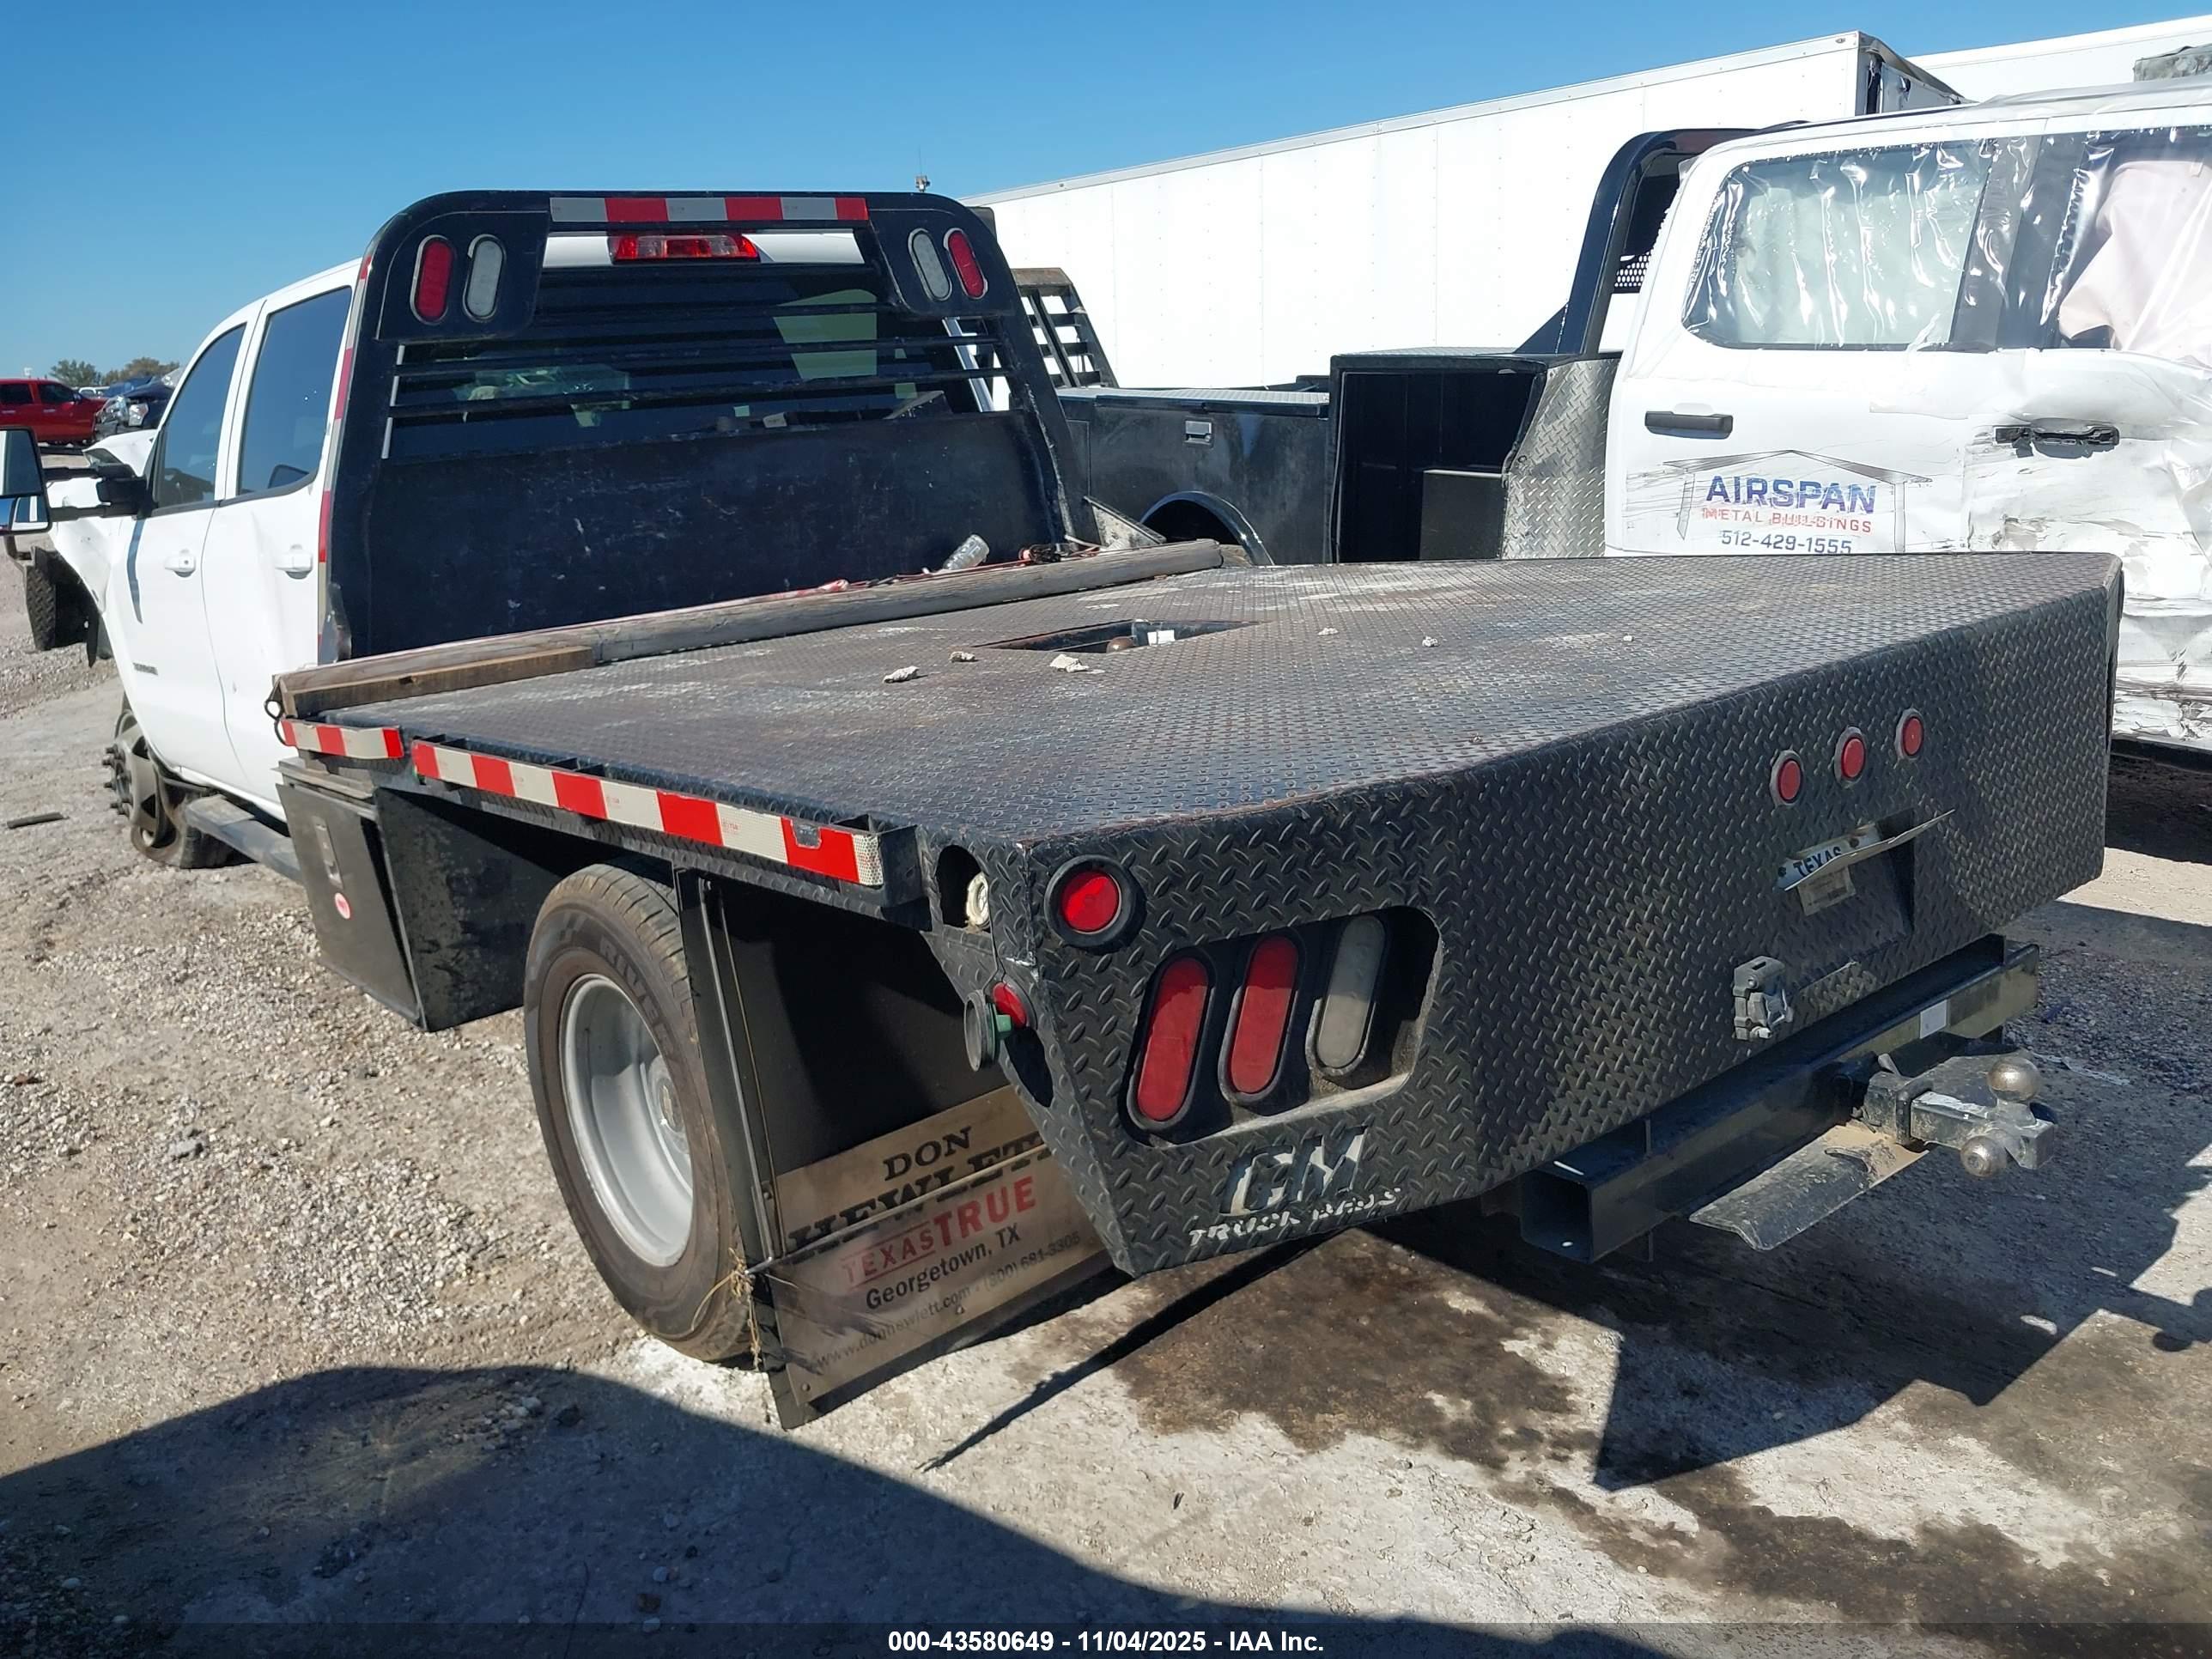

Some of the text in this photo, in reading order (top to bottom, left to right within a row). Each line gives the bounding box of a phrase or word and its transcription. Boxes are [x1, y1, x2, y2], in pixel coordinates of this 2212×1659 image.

[1706, 475, 1877, 514] AIRSPAN
[1703, 507, 1873, 534] METAL BUILDINGS
[1721, 529, 1852, 554] 512-429-1555
[882, 1126, 972, 1182] DON
[866, 1223, 1021, 1310] Georgetown, TX
